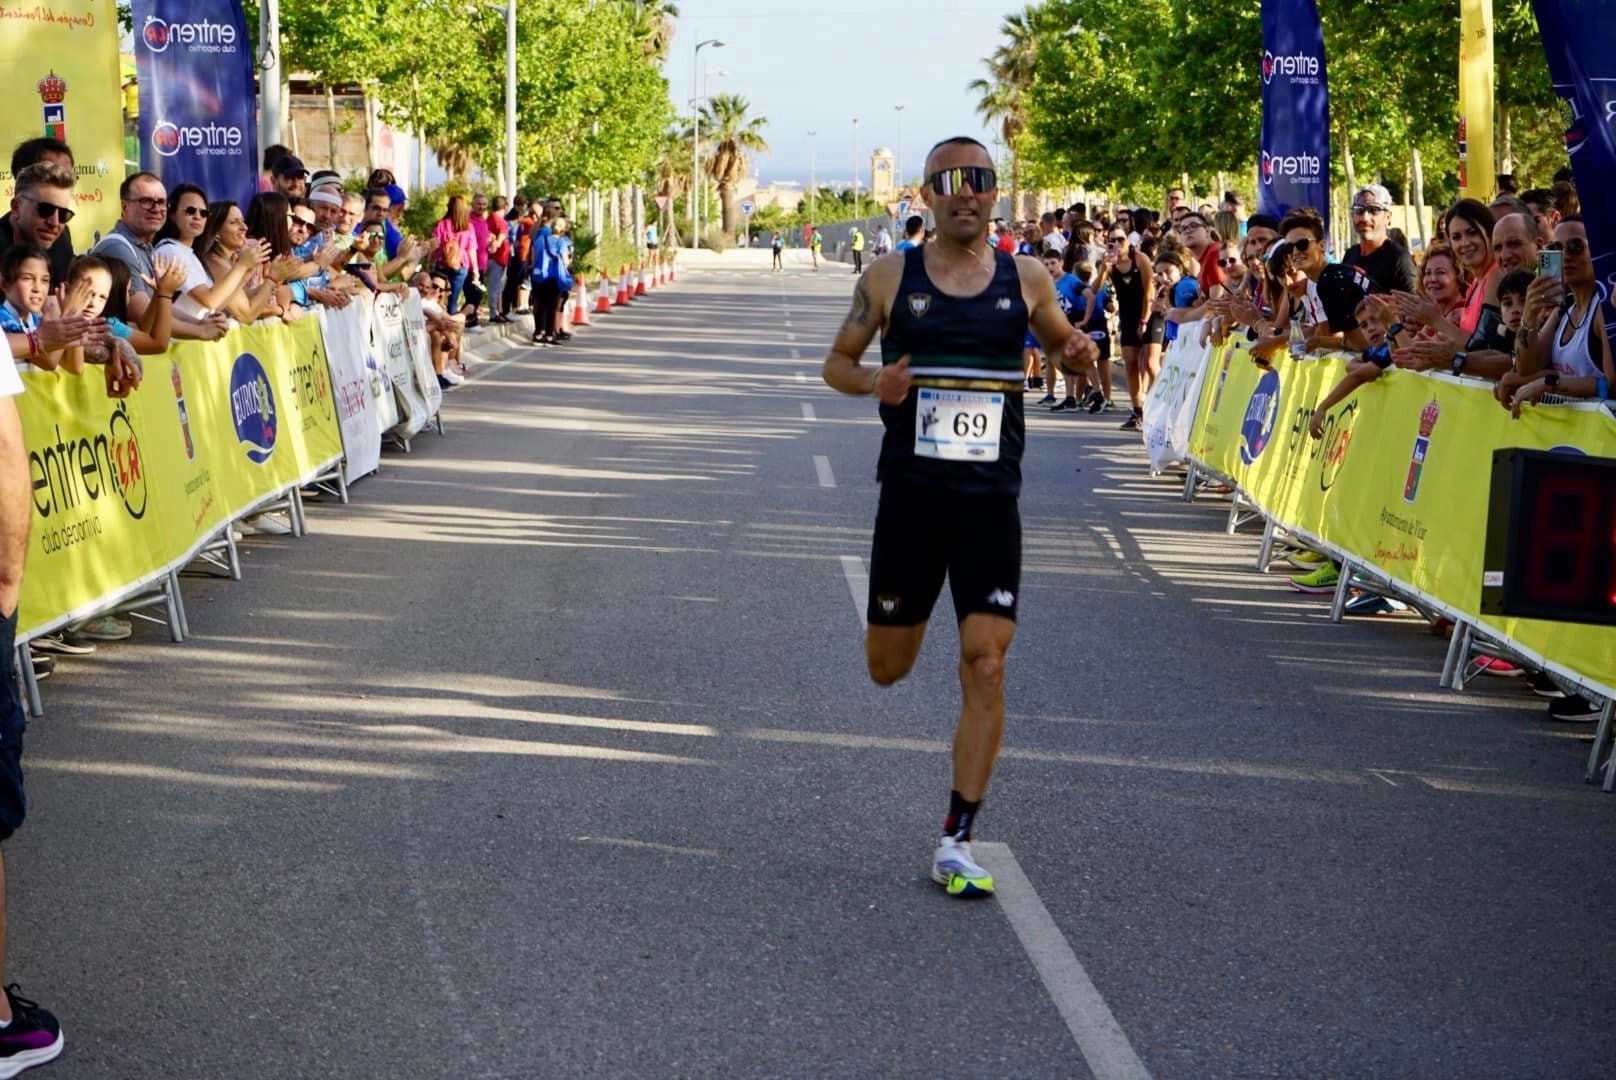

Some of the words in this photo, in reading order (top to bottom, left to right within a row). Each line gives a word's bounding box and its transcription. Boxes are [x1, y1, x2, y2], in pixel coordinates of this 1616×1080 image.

[232, 380, 275, 426] EUROSL
[953, 411, 988, 438] 69
[42, 524, 62, 555] club
[60, 515, 103, 548] deportivo
